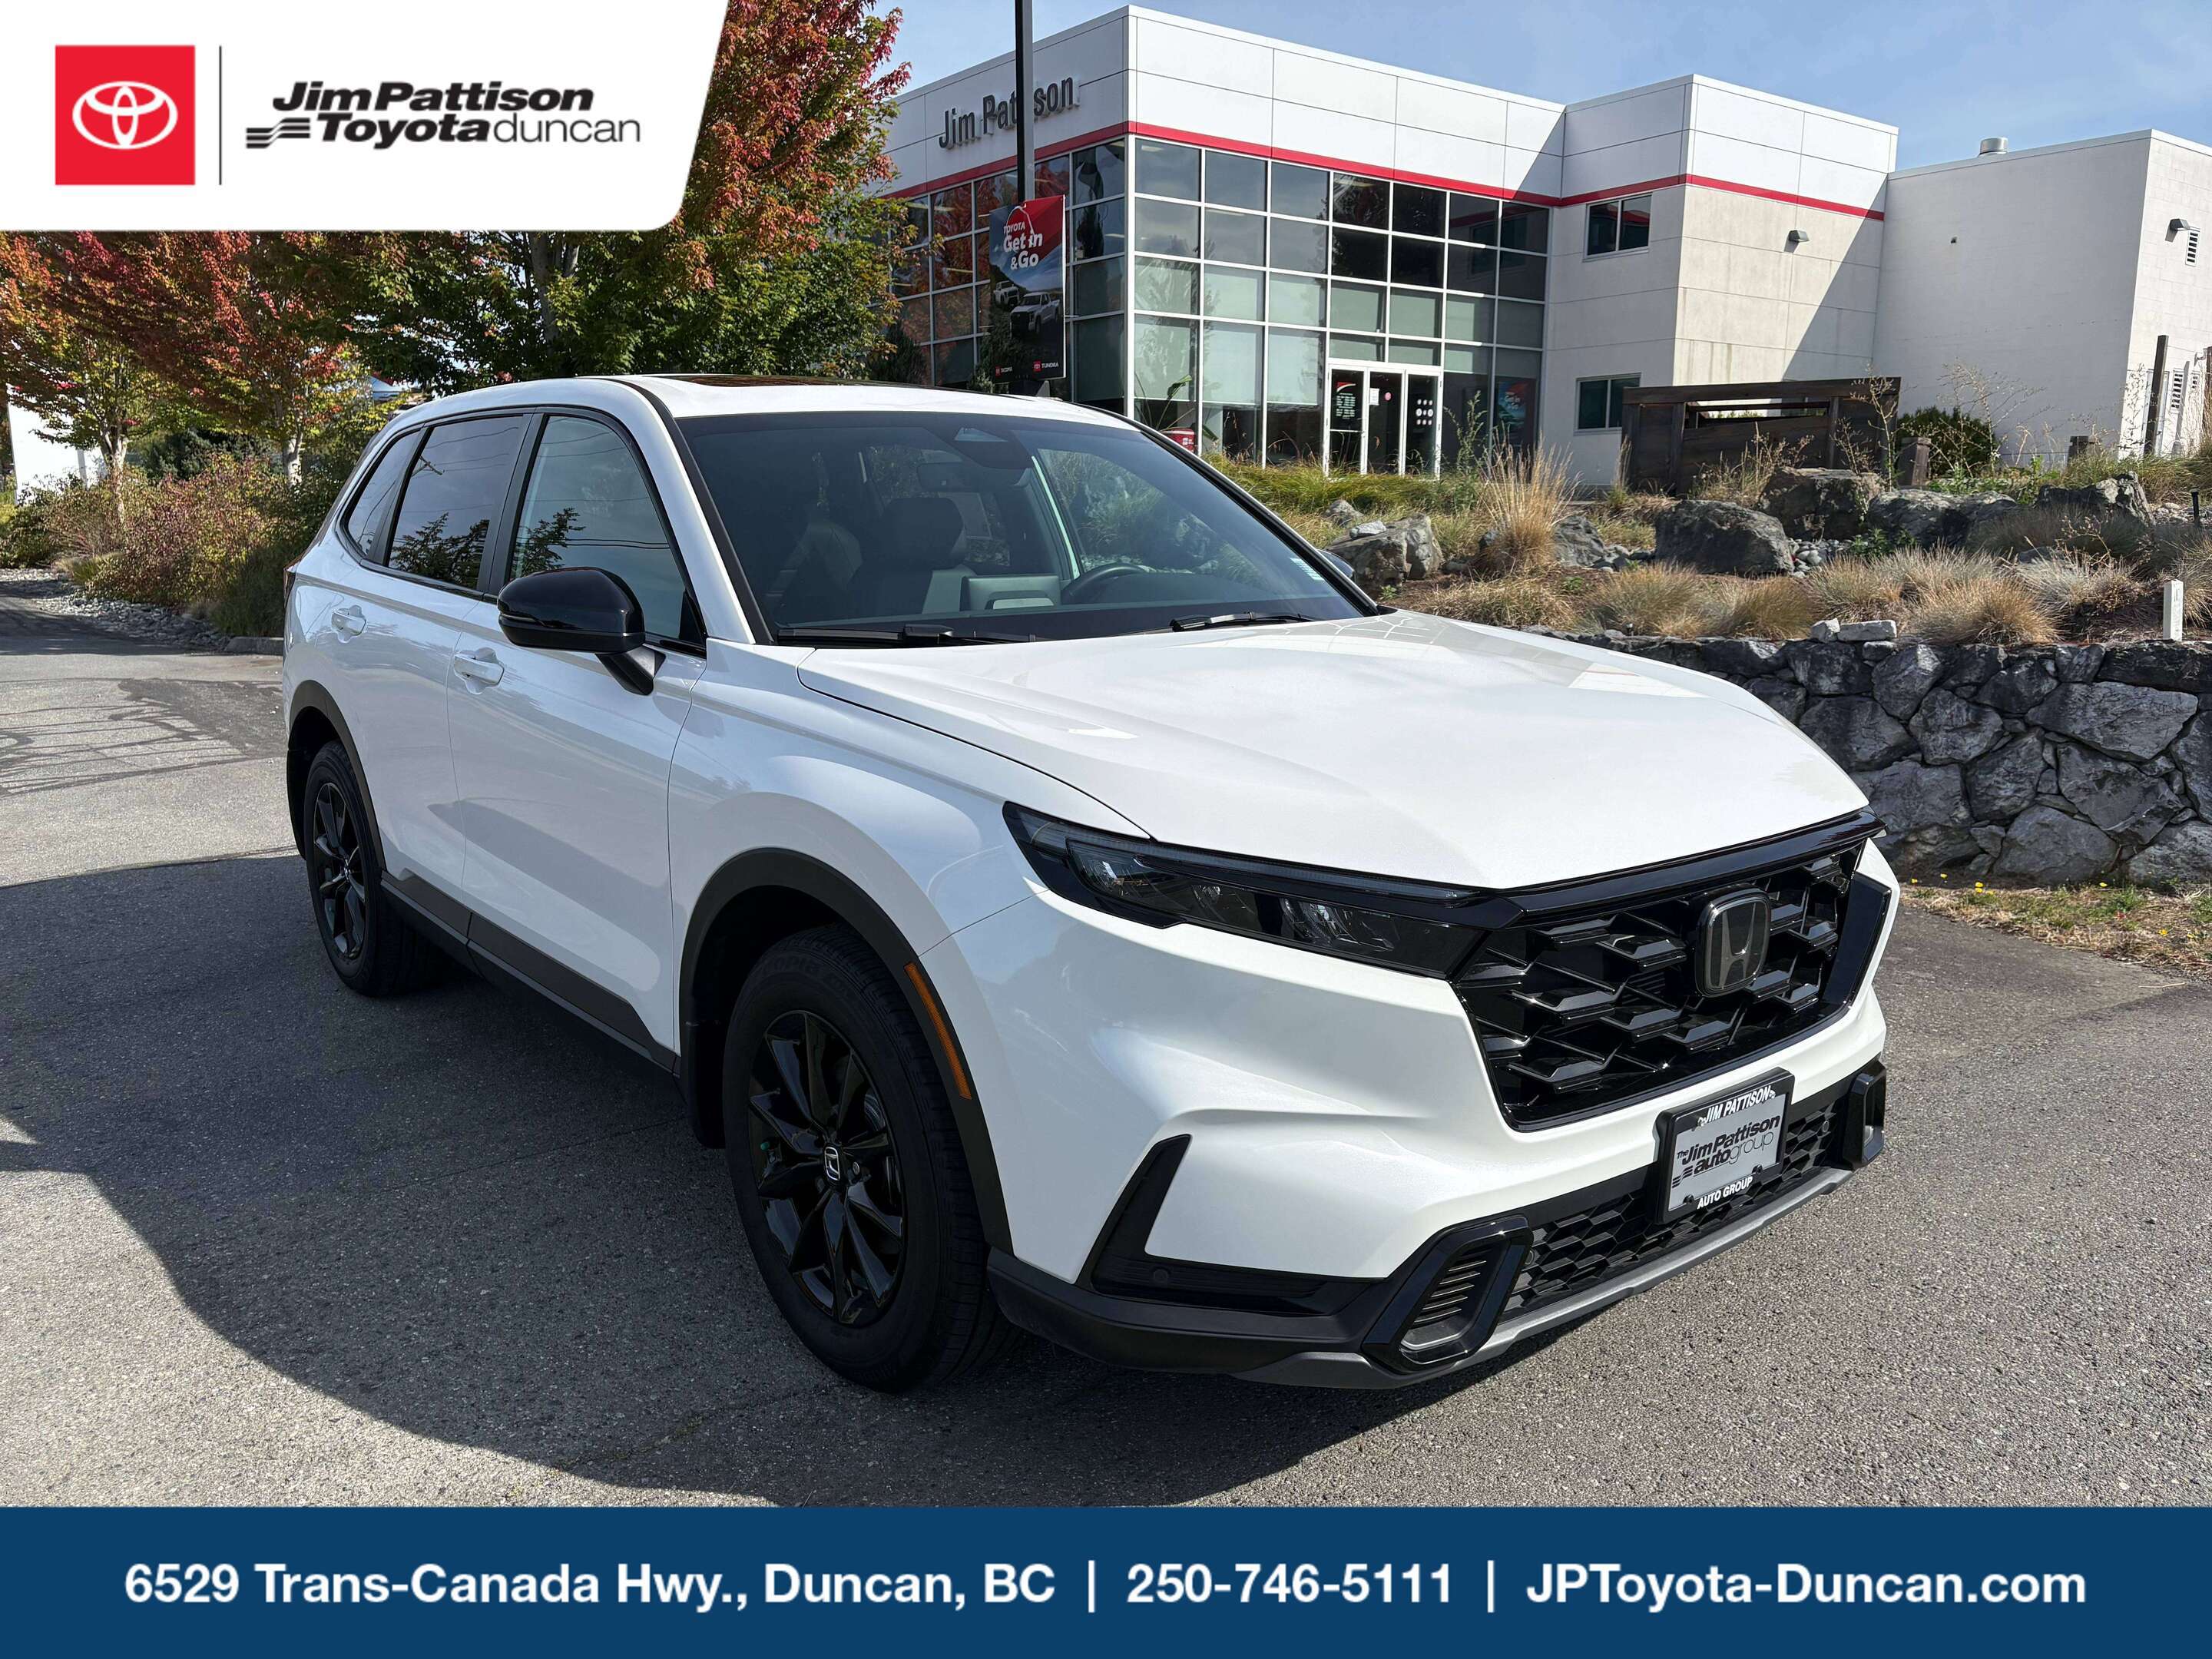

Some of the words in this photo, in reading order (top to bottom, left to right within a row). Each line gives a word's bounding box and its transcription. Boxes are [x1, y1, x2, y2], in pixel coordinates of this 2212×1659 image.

[939, 108, 977, 149] Jim
[983, 77, 1075, 135] Patson
[1003, 221, 1026, 234] TOYOTA
[1003, 233, 1027, 253] Get
[1028, 230, 1043, 248] in
[1704, 1104, 1724, 1124] JIM
[1723, 1084, 1772, 1117] PATTISON
[1697, 1189, 1722, 1210] AUTO
[1722, 1176, 1753, 1198] GROUP
